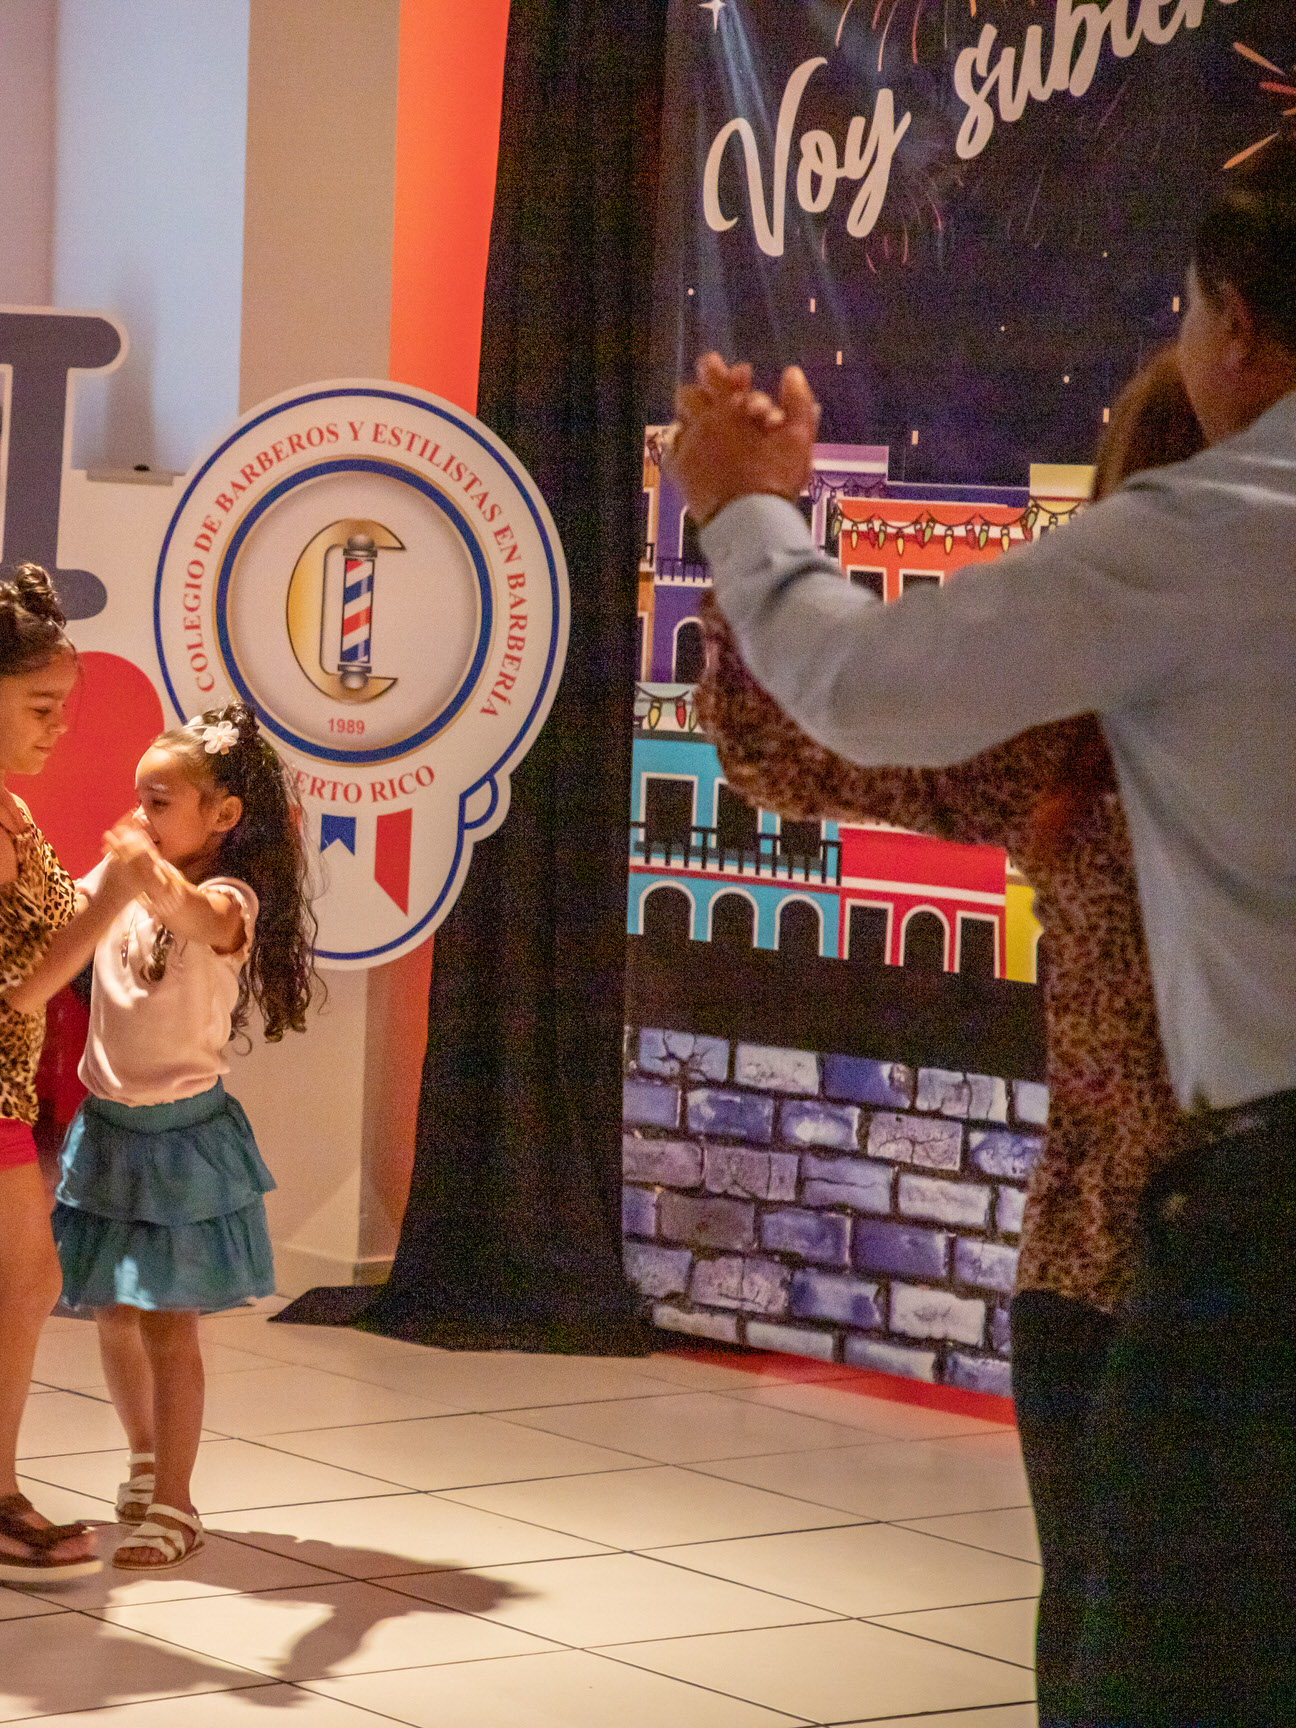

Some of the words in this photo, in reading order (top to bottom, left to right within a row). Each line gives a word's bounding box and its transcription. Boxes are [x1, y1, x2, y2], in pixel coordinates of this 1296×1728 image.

[703, 57, 911, 257] Voy
[347, 421, 366, 442] Y
[215, 423, 340, 513] BARBEROS
[373, 422, 502, 522] ESTILISTAS
[193, 515, 222, 553] DE
[493, 525, 522, 564] EN
[182, 560, 215, 692] COLEGIO
[480, 572, 528, 716] BARBERÍA
[328, 717, 365, 735] 1989
[294, 769, 363, 804] ERTO
[370, 765, 435, 803] RICO
